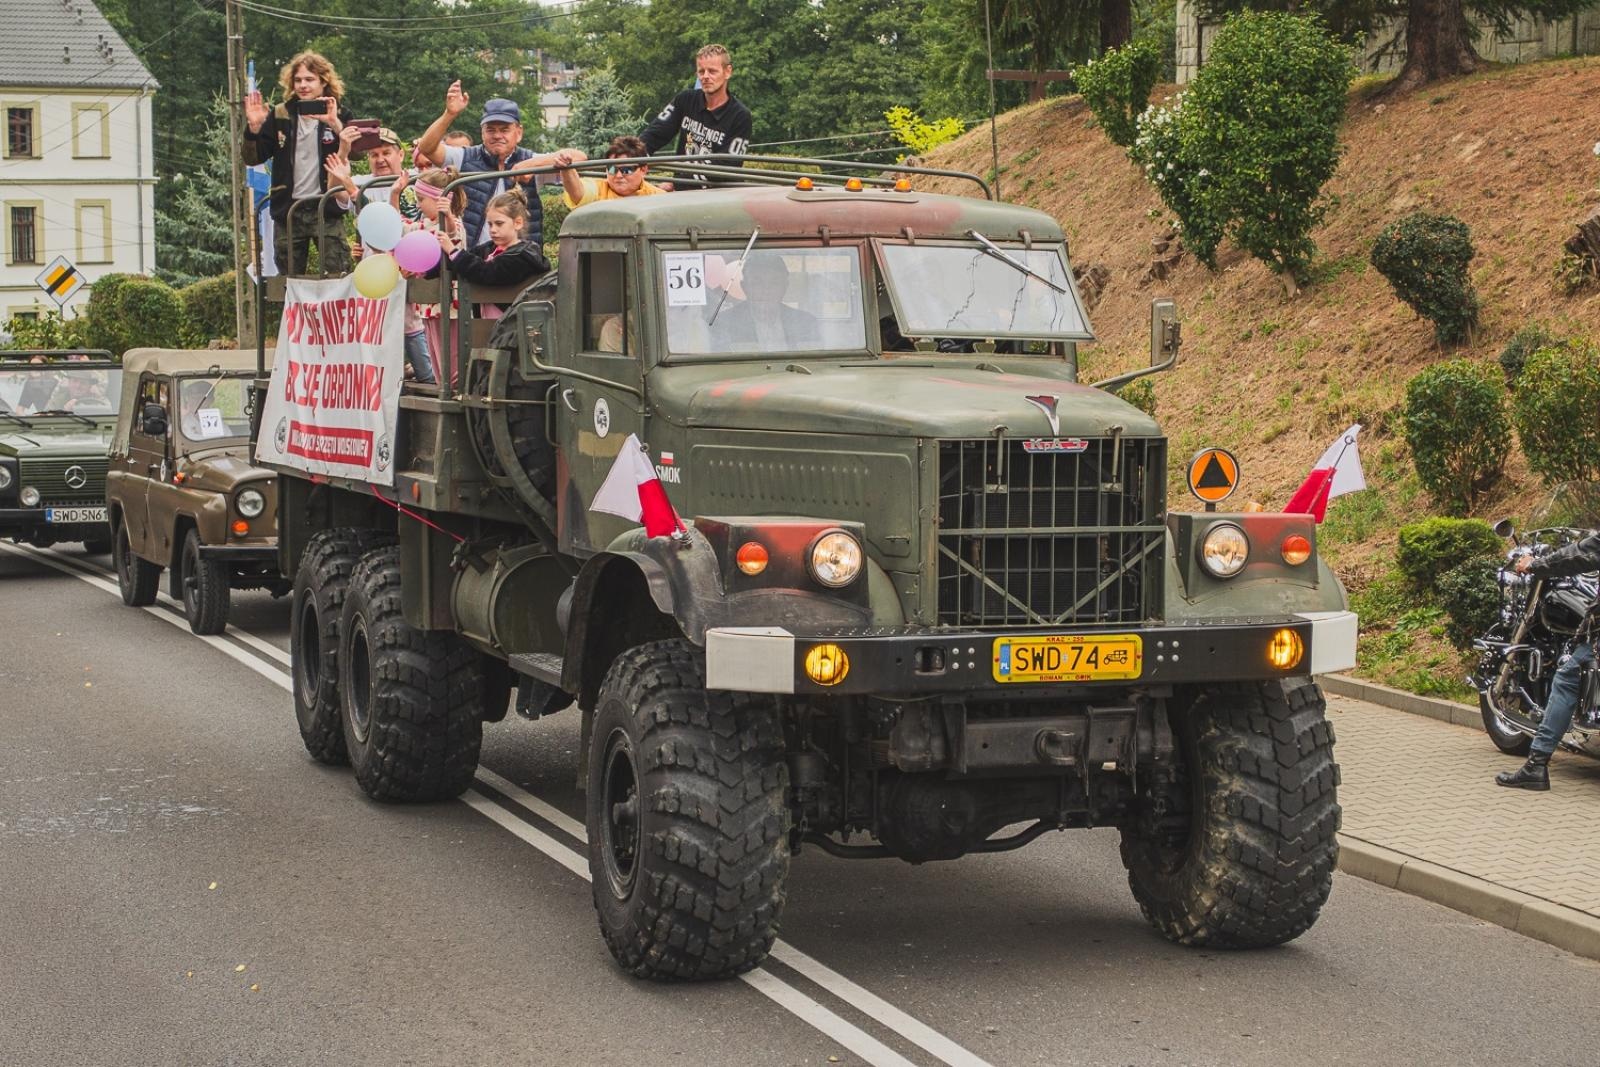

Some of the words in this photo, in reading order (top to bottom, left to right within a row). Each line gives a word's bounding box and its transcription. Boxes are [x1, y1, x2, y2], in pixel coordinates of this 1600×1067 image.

[669, 265, 702, 289] 56
[320, 298, 346, 345] NIE
[655, 465, 681, 484] SMOK
[54, 510, 78, 521] SWD
[1000, 662, 1009, 670] PL
[1015, 647, 1061, 671] SWD
[1071, 646, 1098, 671] 74
